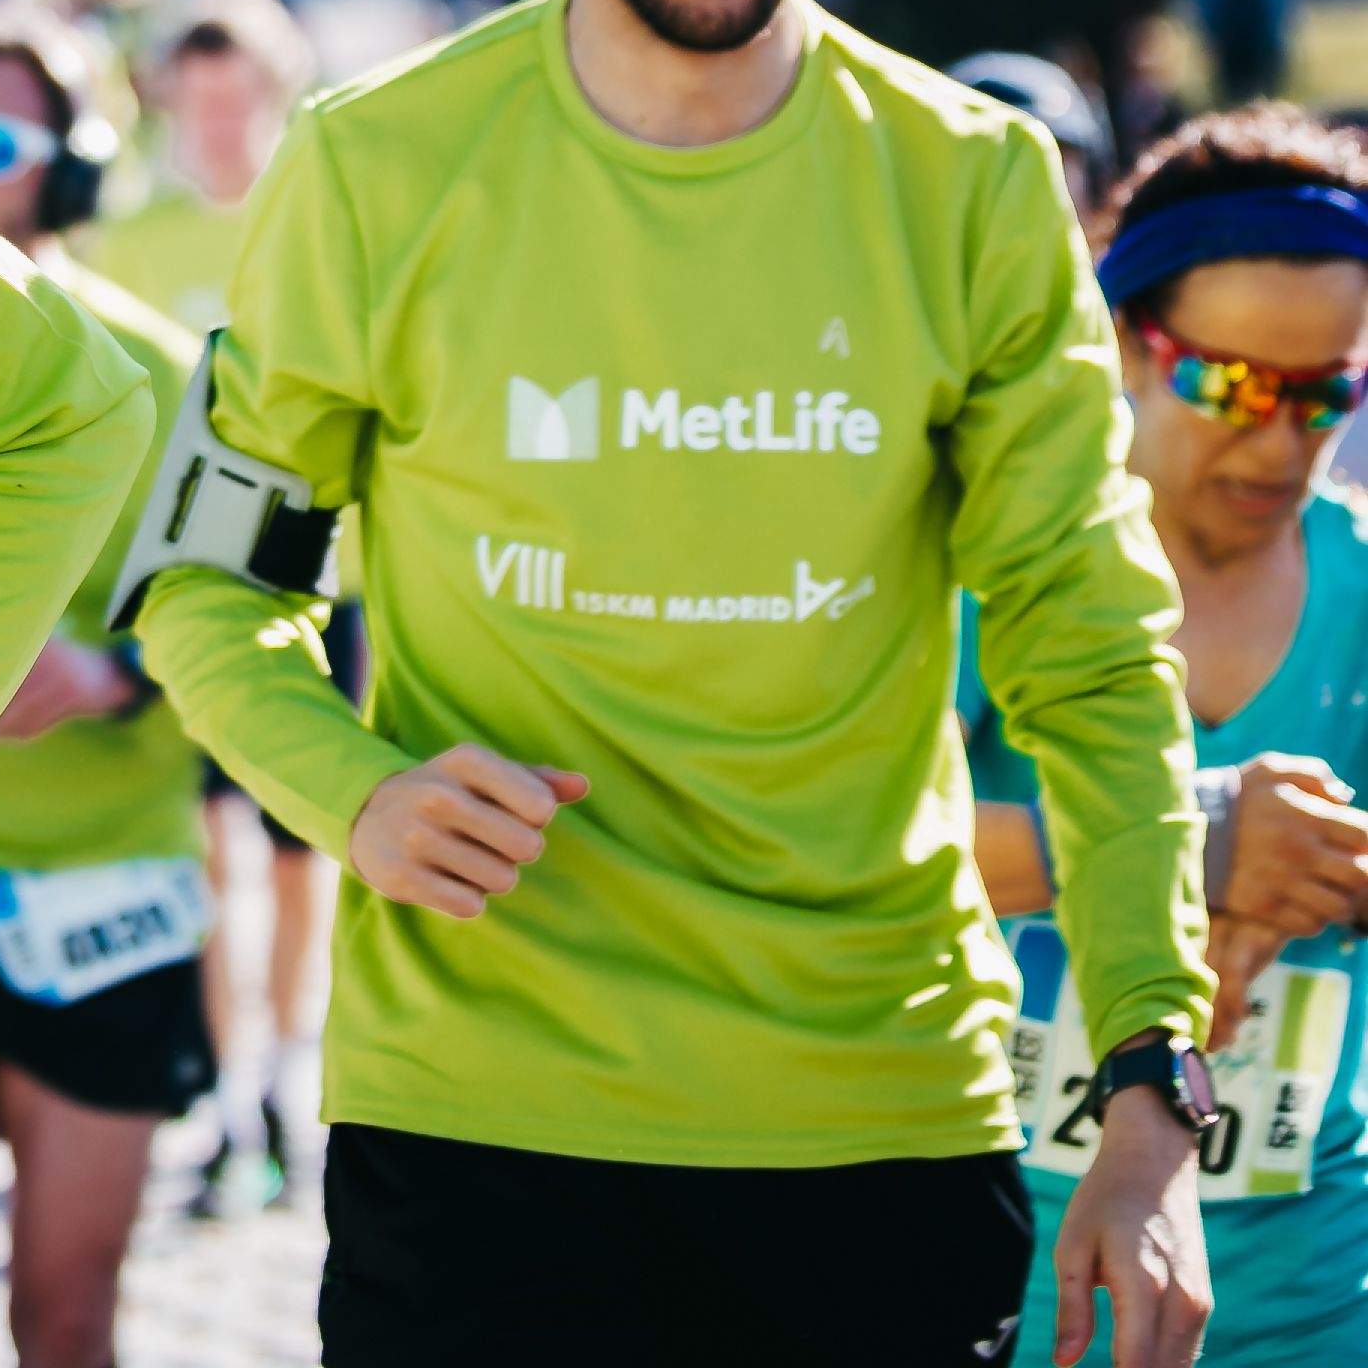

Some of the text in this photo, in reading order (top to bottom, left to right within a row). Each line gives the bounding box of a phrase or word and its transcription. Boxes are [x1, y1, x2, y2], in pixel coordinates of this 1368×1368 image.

[619, 387, 882, 456] MetLife
[474, 533, 795, 623] VIII 15KM MADRID
